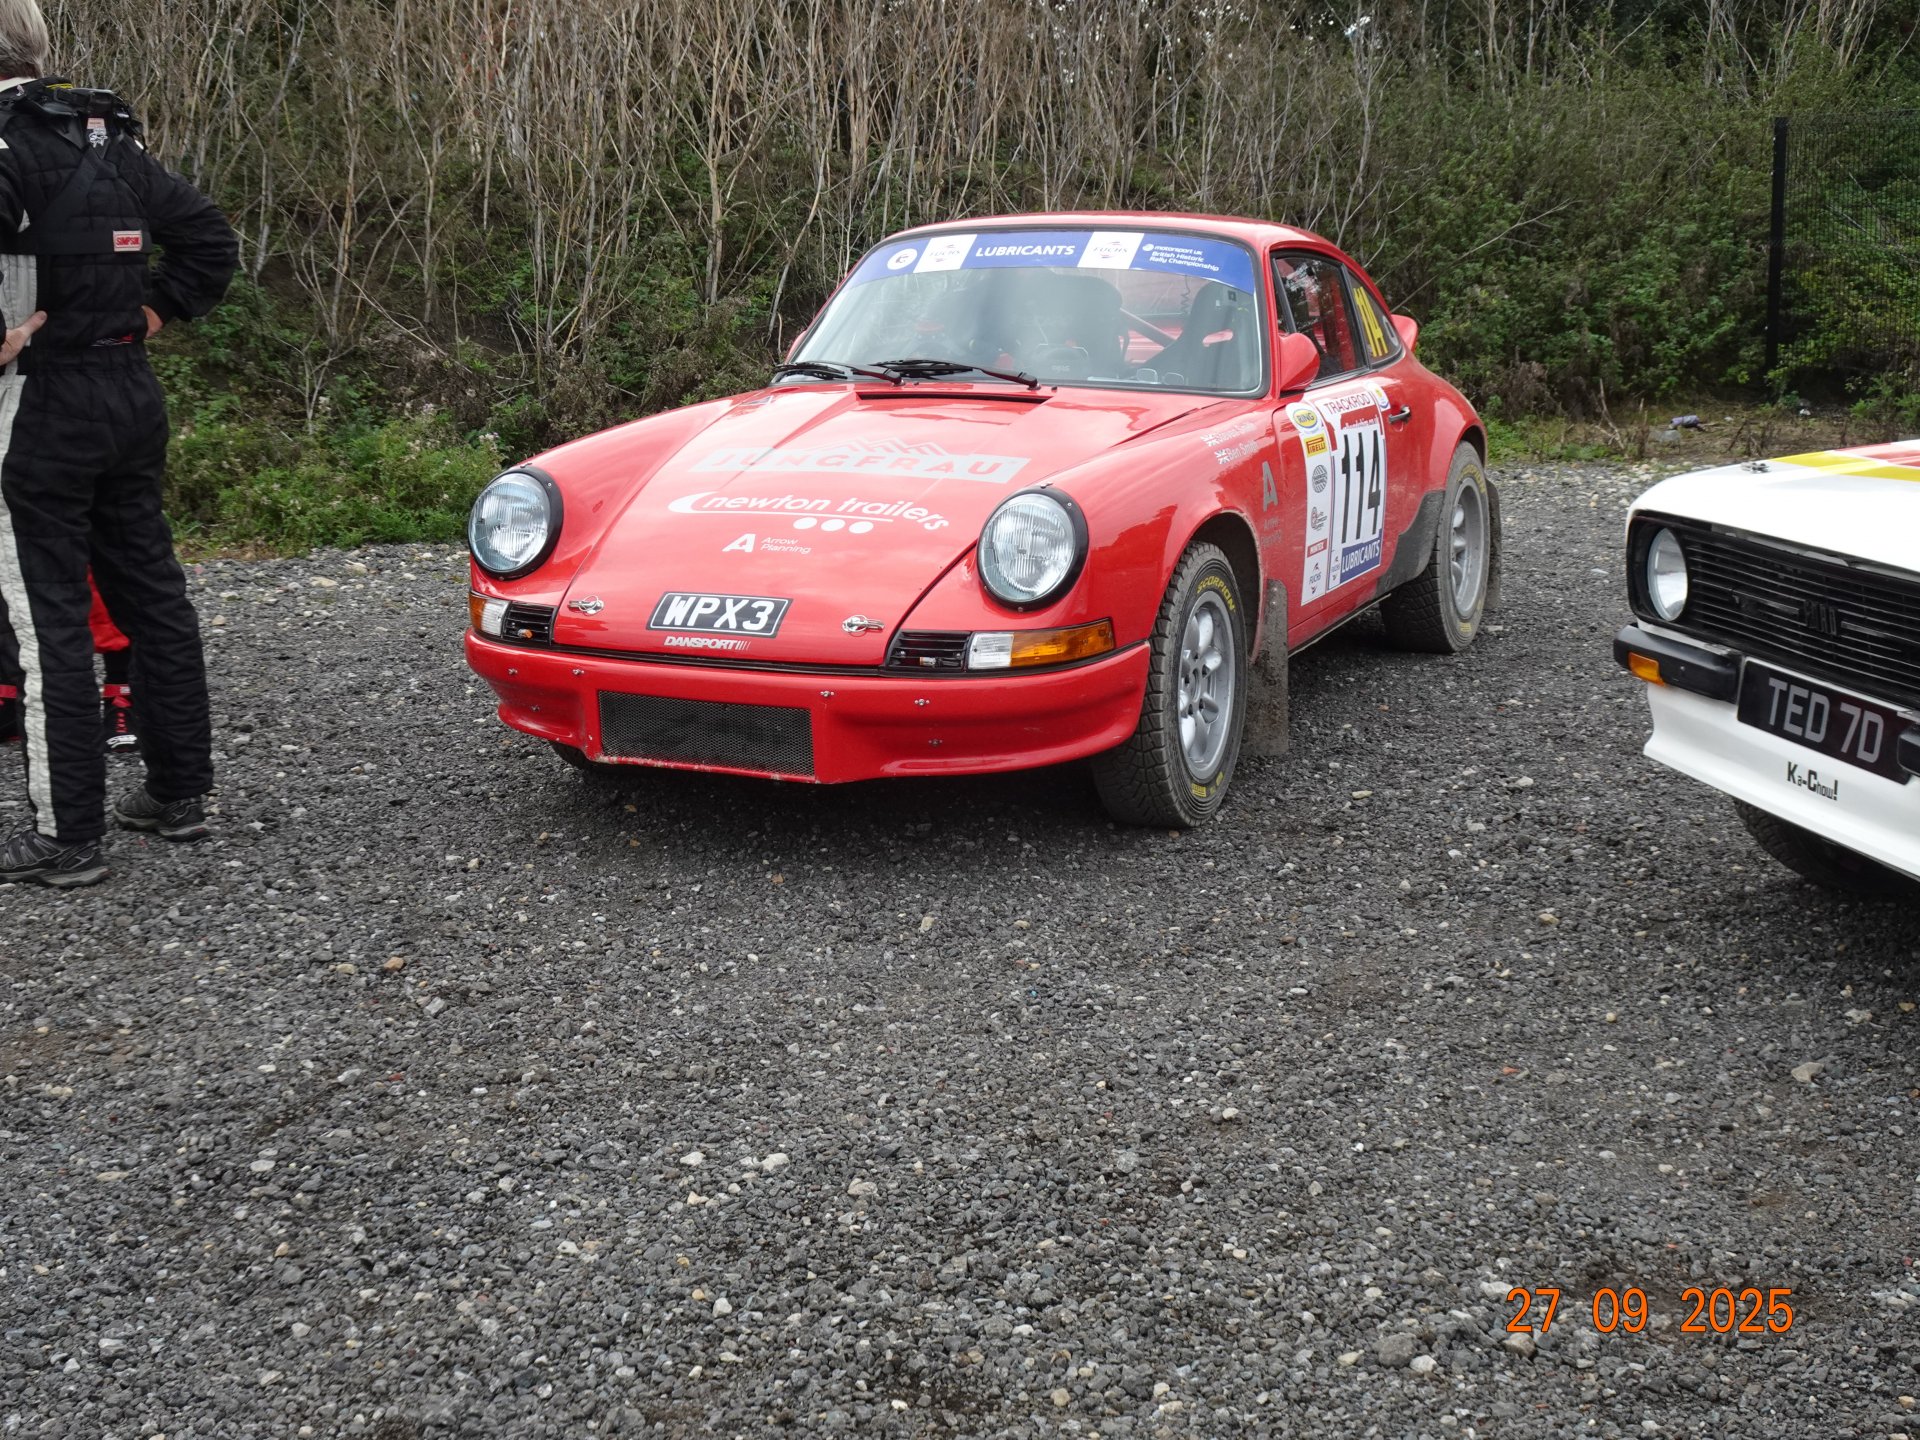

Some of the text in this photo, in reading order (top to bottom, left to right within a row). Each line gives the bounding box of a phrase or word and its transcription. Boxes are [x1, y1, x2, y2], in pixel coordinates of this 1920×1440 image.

[975, 245, 1076, 257] LUBRICANTS
[1093, 246, 1128, 254] FUCHS
[1154, 245, 1193, 254] motorsport
[1176, 253, 1205, 262] Historic
[1168, 258, 1220, 272] Championship
[1323, 393, 1371, 415] TRACKROD
[1296, 412, 1315, 423] RING
[1306, 436, 1326, 454] PIRELLI
[713, 448, 1006, 477] JUNGFRAU
[1341, 429, 1382, 544] 114
[701, 493, 950, 531] newton trailers
[761, 536, 799, 546] Arrow
[761, 542, 812, 556] Planning
[1341, 539, 1381, 573] LUBRICANTS
[1308, 571, 1322, 585] FUCHS
[1196, 575, 1236, 613] SCORPION
[662, 595, 775, 631] WPX3
[1768, 677, 1884, 764] TED 7D
[1787, 760, 1839, 801] Ka-Chow!
